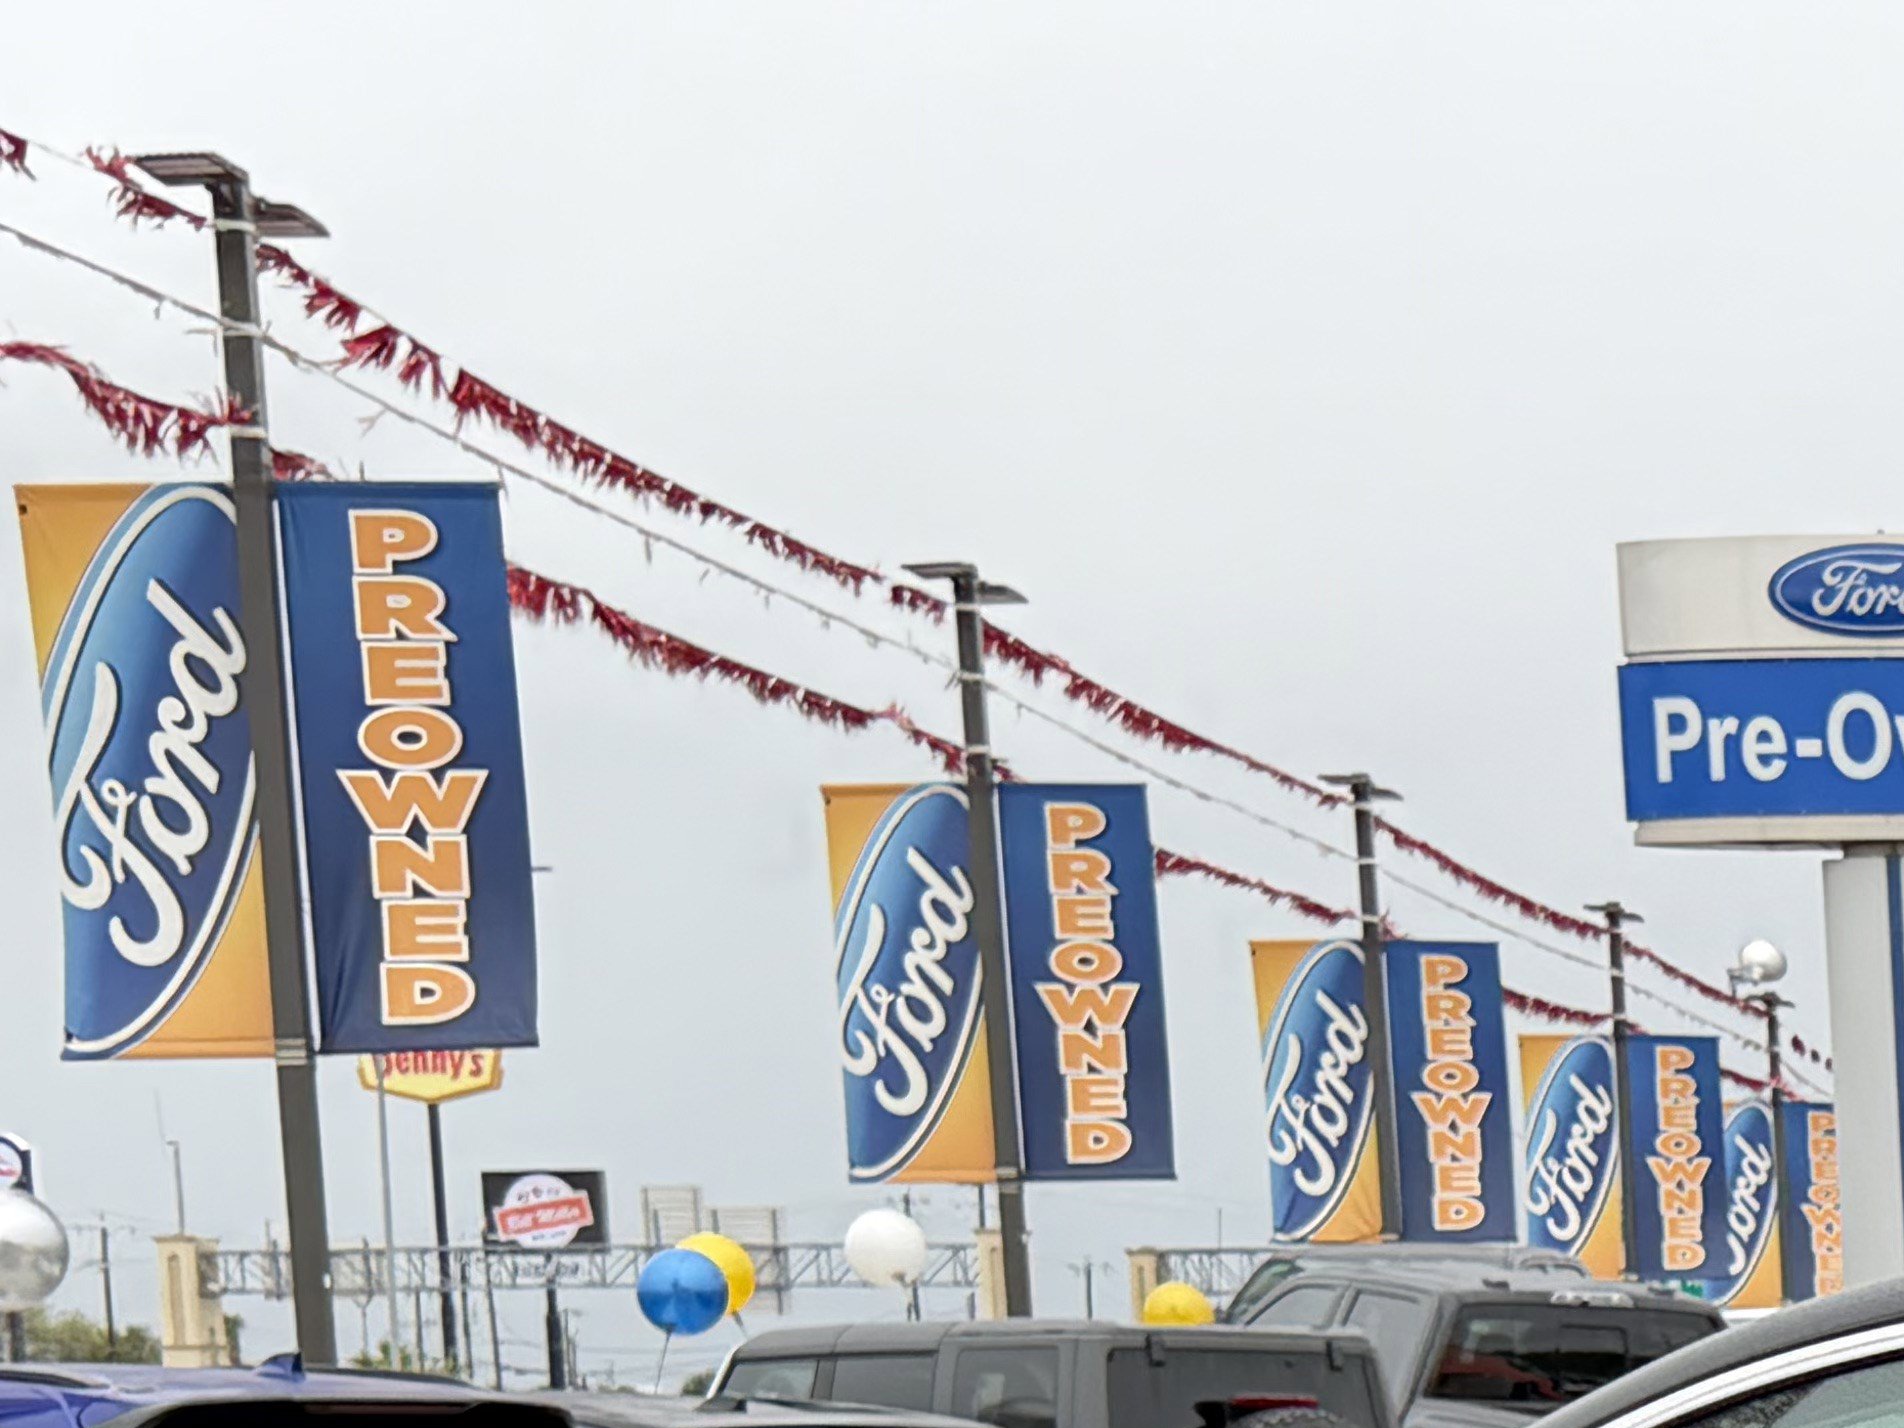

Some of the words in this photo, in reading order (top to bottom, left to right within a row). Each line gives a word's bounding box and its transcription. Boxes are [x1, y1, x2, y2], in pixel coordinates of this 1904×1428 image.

[59, 577, 247, 967] Ford
[335, 508, 489, 1025] PREOWNED
[373, 1050, 485, 1080] ennys
[839, 846, 975, 1117] Ford
[1032, 801, 1141, 1165] PREOWNED
[1266, 989, 1368, 1197] Ford
[1411, 953, 1495, 1232] PREOWNED
[1525, 1073, 1612, 1242] Ford
[1646, 1045, 1712, 1272] PREOWNED
